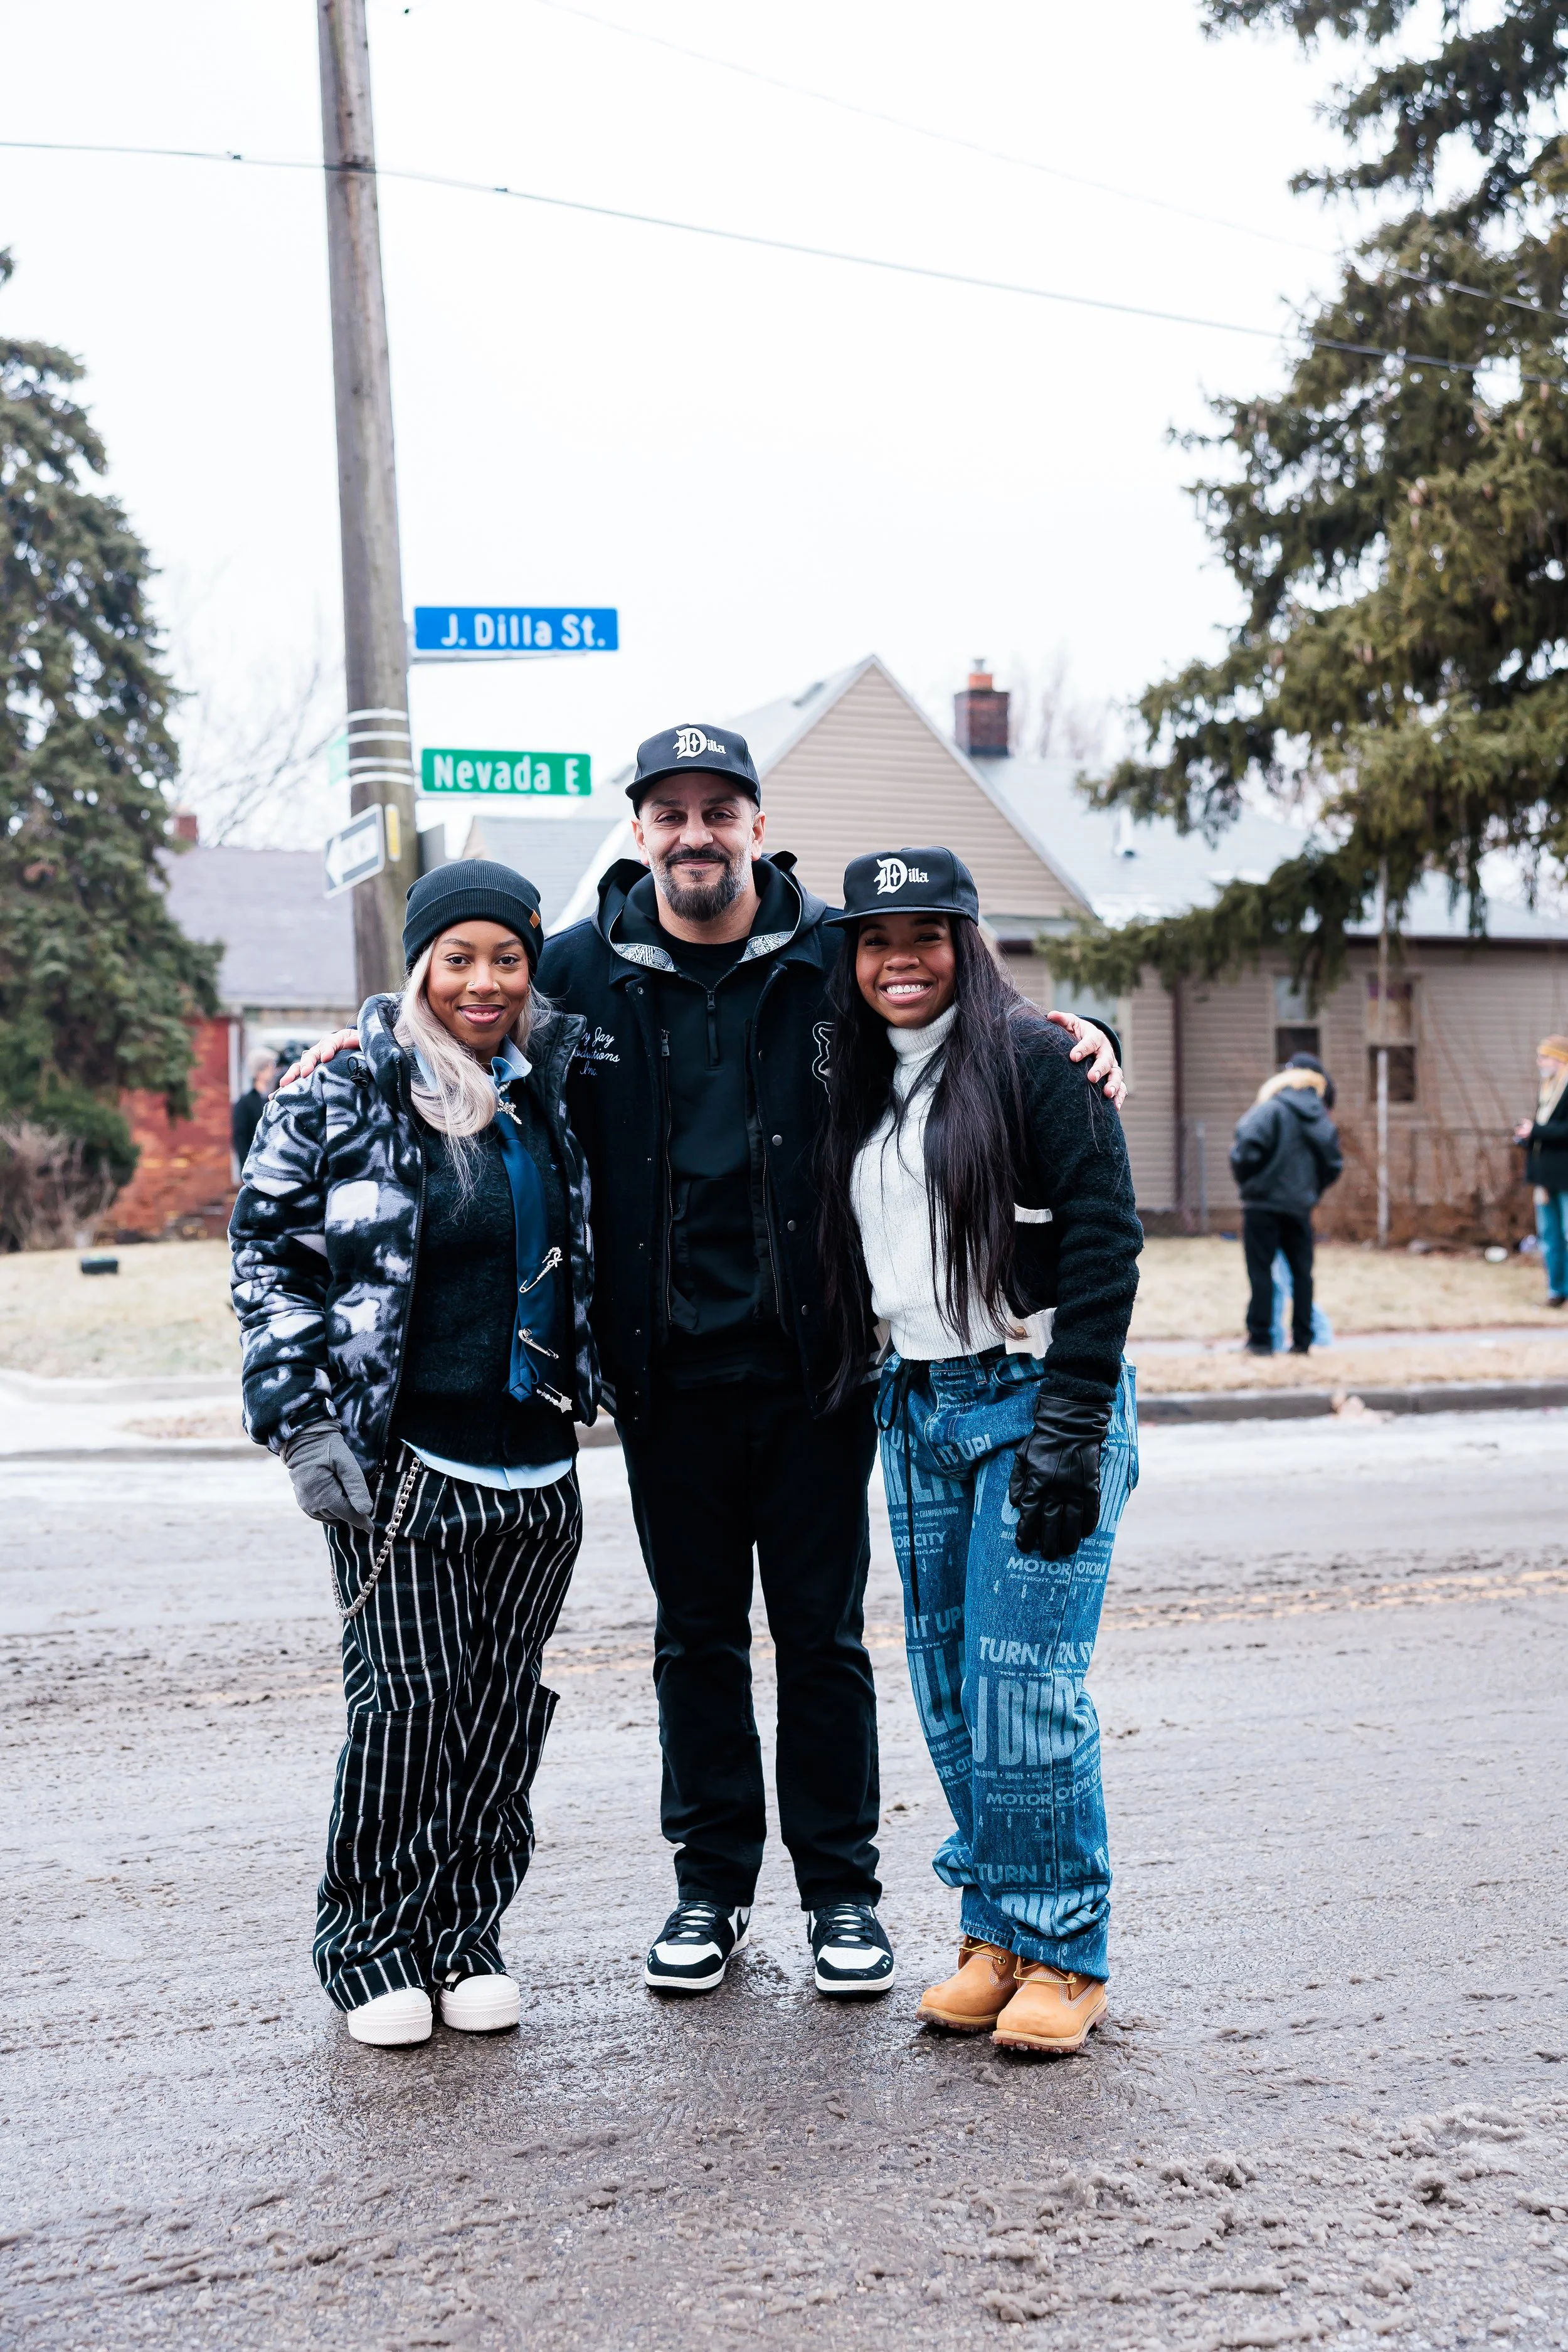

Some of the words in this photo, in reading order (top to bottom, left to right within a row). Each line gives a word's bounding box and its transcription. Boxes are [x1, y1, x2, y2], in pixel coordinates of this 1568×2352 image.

[441, 613, 467, 647] J.
[474, 613, 552, 647] Dilla
[561, 614, 605, 647] St.
[673, 728, 726, 760] Dilla
[433, 754, 551, 792] Nevada
[564, 758, 580, 793] E
[874, 858, 930, 895] Dilla
[592, 1027, 615, 1049] Jay
[956, 1433, 992, 1461] UP!
[919, 1508, 942, 1518] CHAMPION
[943, 1506, 959, 1516] SOUND
[914, 1530, 946, 1547] CITY
[1006, 1555, 1072, 1576] MOTOR
[979, 1636, 1041, 1666] TURN
[986, 1792, 1053, 1806] MOTOR
[974, 1863, 1037, 1884] TURN
